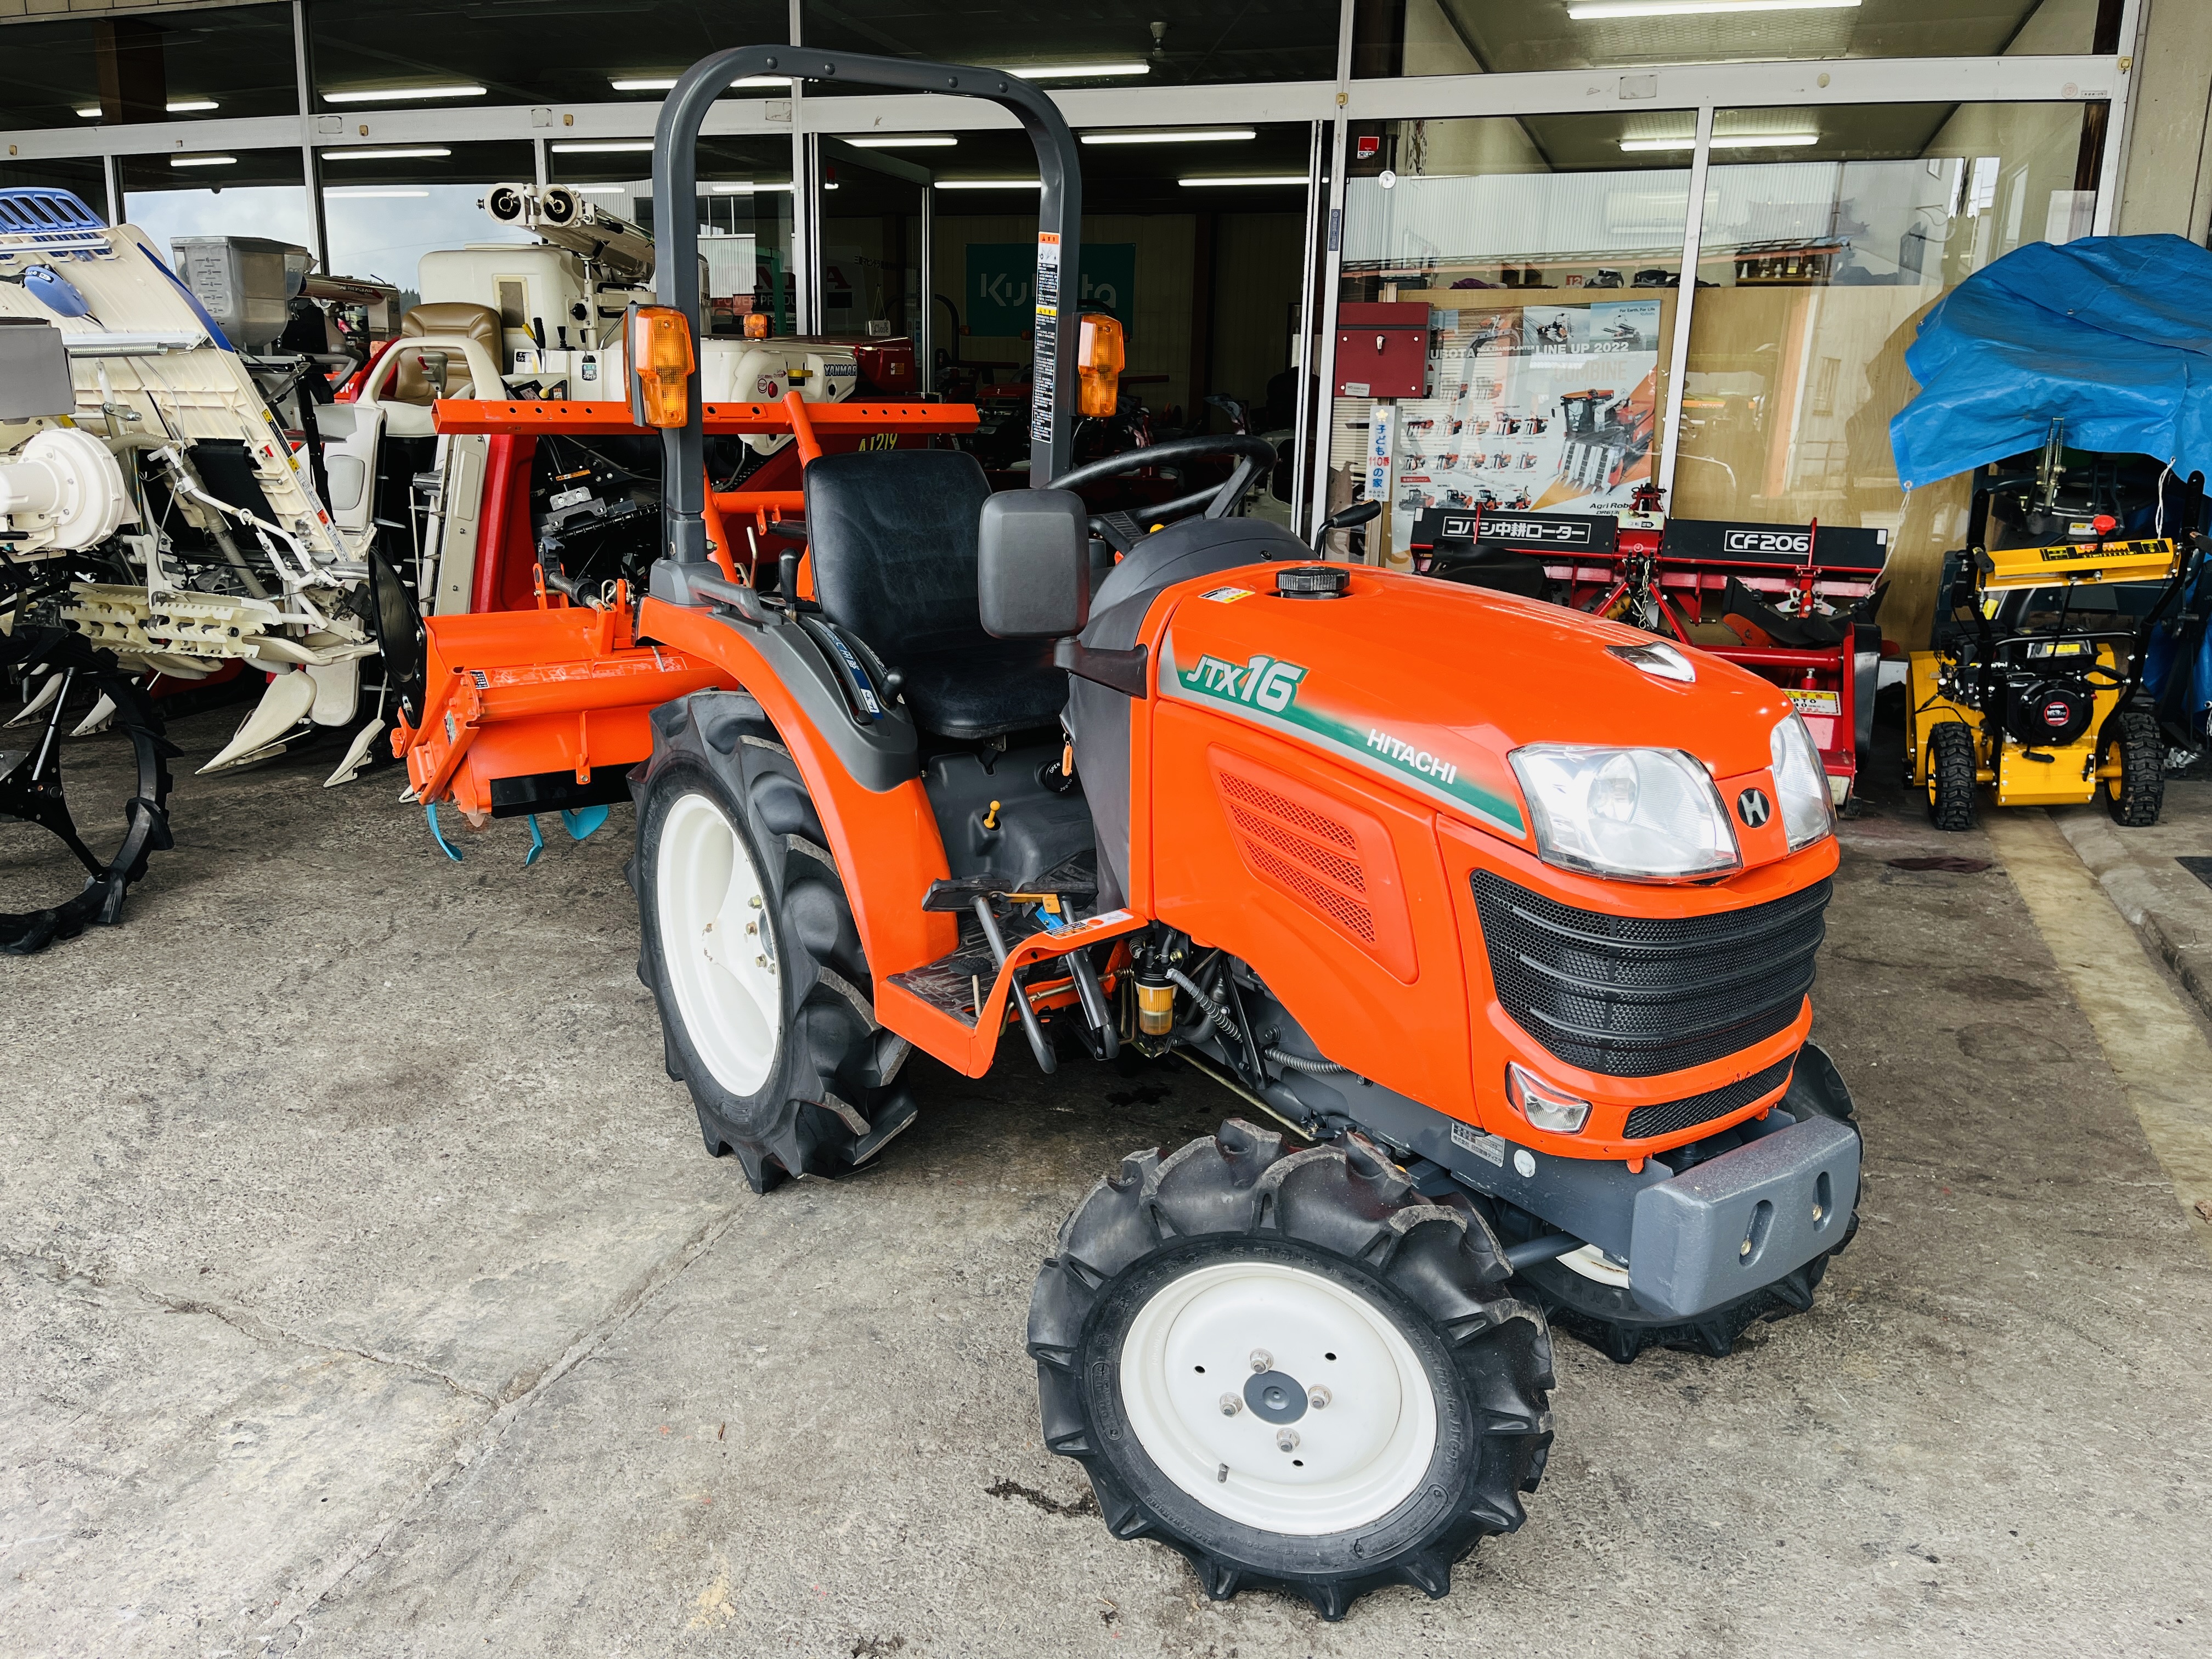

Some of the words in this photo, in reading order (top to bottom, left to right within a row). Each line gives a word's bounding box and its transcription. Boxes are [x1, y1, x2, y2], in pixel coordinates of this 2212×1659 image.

[1567, 276, 1582, 285] 12
[980, 273, 1117, 308] Kuta
[1430, 347, 1476, 360] UBOTA
[1536, 344, 1566, 356] LINE
[1571, 343, 1590, 354] UP
[1594, 341, 1629, 353] 2022
[824, 364, 857, 377] YANMAR
[1730, 533, 1809, 552] CF206
[1186, 656, 1303, 713] JTX16
[1367, 728, 1457, 785] HITACHI
